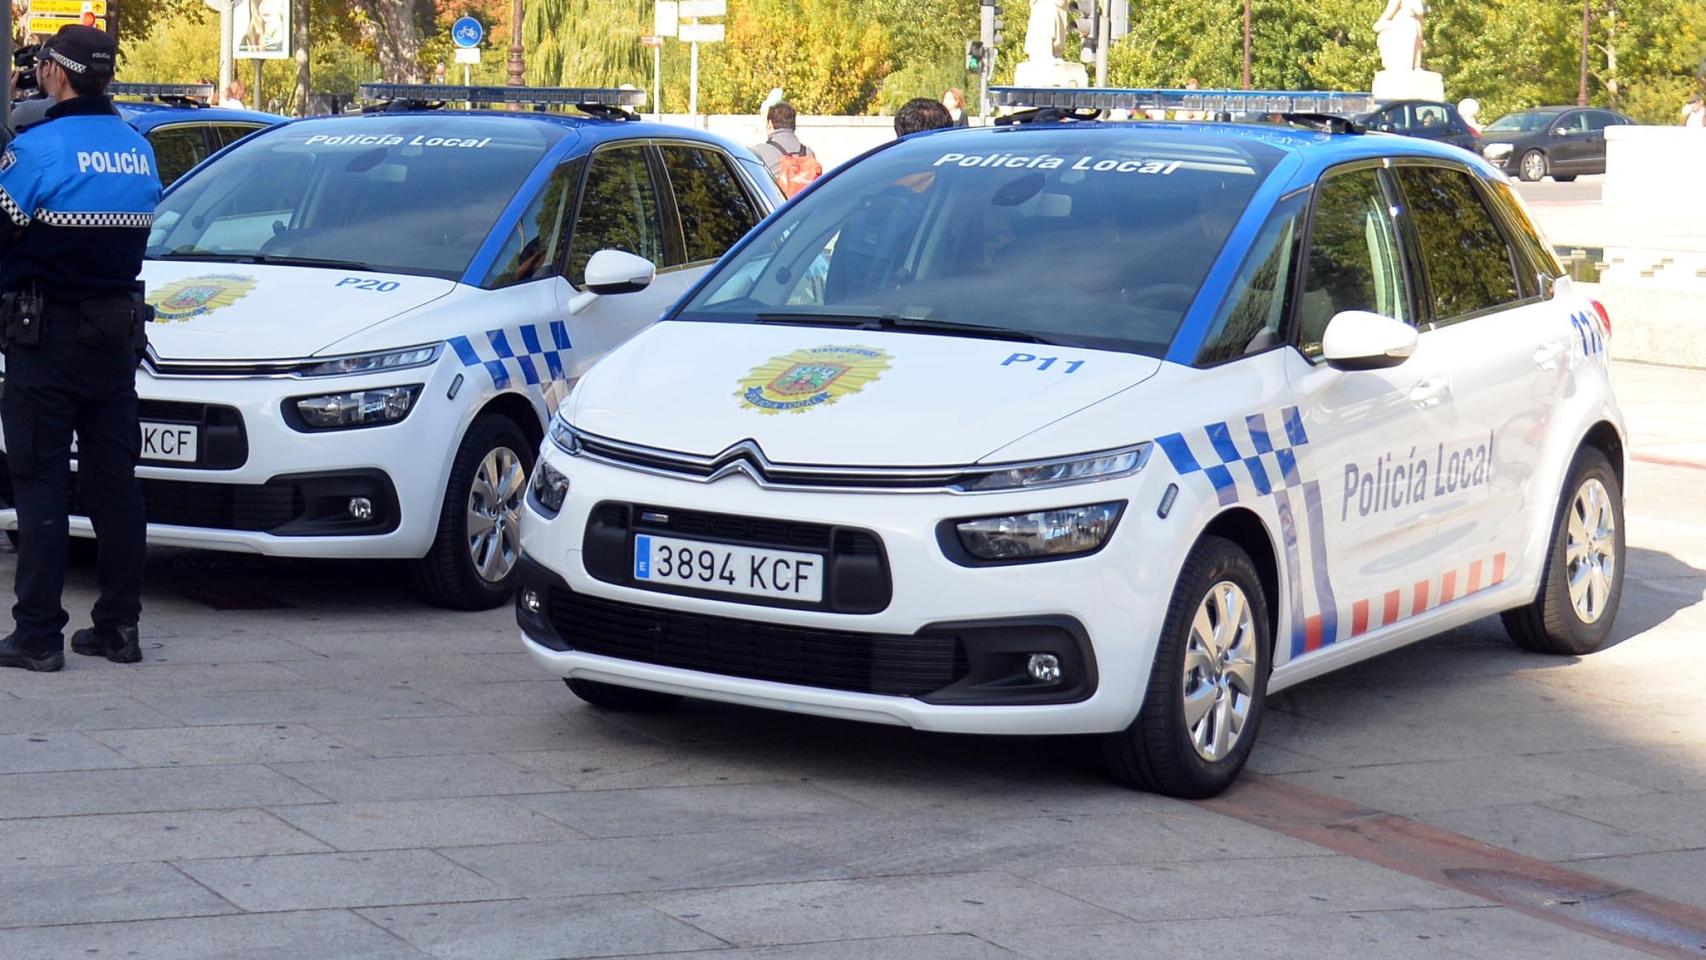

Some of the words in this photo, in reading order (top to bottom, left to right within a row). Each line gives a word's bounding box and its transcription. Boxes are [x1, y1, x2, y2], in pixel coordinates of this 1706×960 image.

[305, 134, 404, 146] Policía
[409, 134, 492, 148] Local
[77, 147, 151, 176] POLICÍA
[932, 152, 1065, 169] Policía
[1071, 156, 1182, 175] Local
[335, 277, 400, 292] P20
[1001, 353, 1086, 374] P11
[144, 427, 191, 456] KCF
[1341, 446, 1428, 522] Policía
[1434, 429, 1494, 497] Local
[657, 545, 736, 585] 3894
[750, 555, 813, 593] KCF
